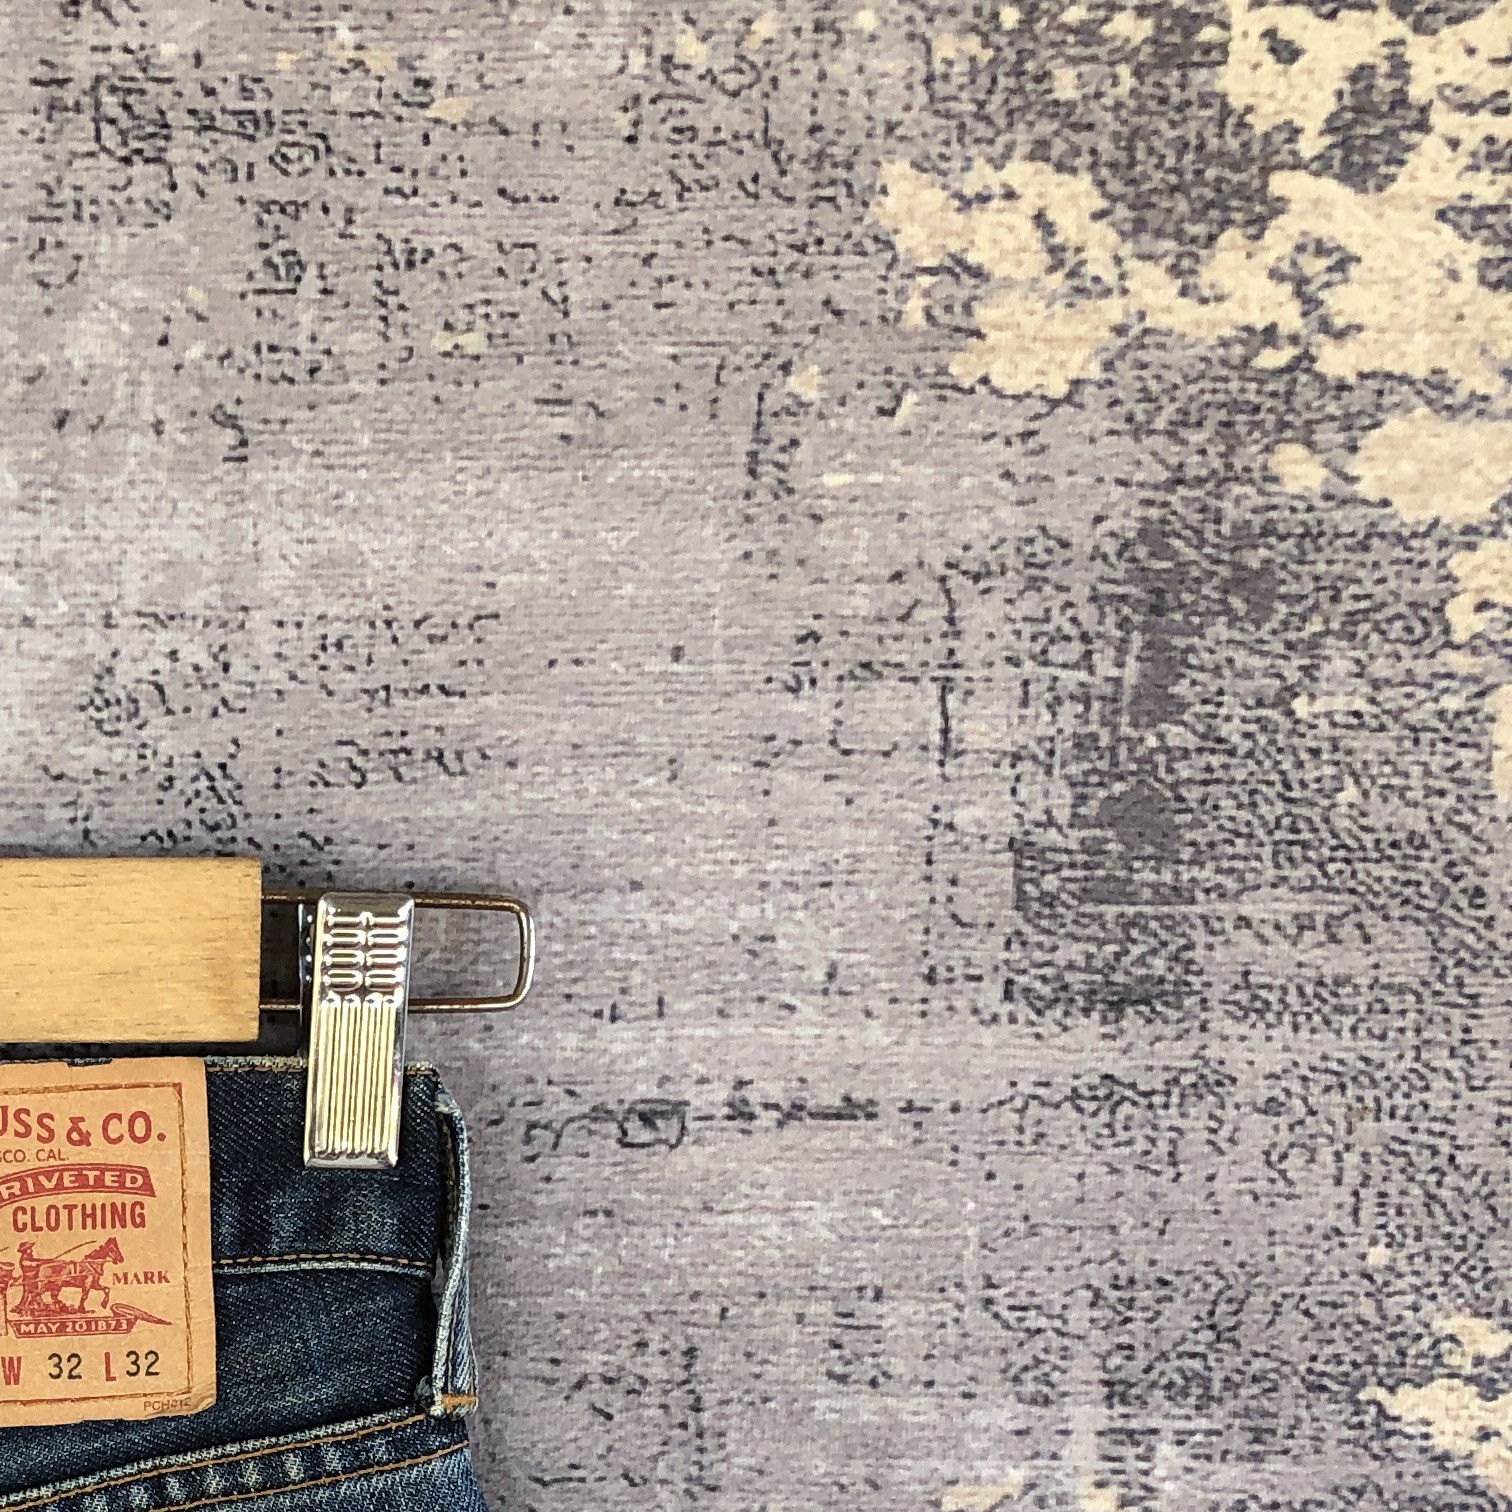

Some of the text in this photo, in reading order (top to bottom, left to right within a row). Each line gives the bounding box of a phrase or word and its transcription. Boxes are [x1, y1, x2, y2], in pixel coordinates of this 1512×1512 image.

[66, 1116, 93, 1147] &
[101, 1111, 167, 1144] CO.
[36, 1148, 69, 1163] CAL.
[0, 1169, 145, 1201] RIVETED
[12, 1201, 146, 1233] CLOTHING
[111, 1269, 171, 1286] MARK
[20, 1321, 62, 1334] MAY
[65, 1320, 88, 1333] 20
[91, 1319, 128, 1332] 1873
[1, 1356, 22, 1386] W
[48, 1352, 82, 1380] 32
[104, 1351, 117, 1382] L
[125, 1350, 160, 1378] 32
